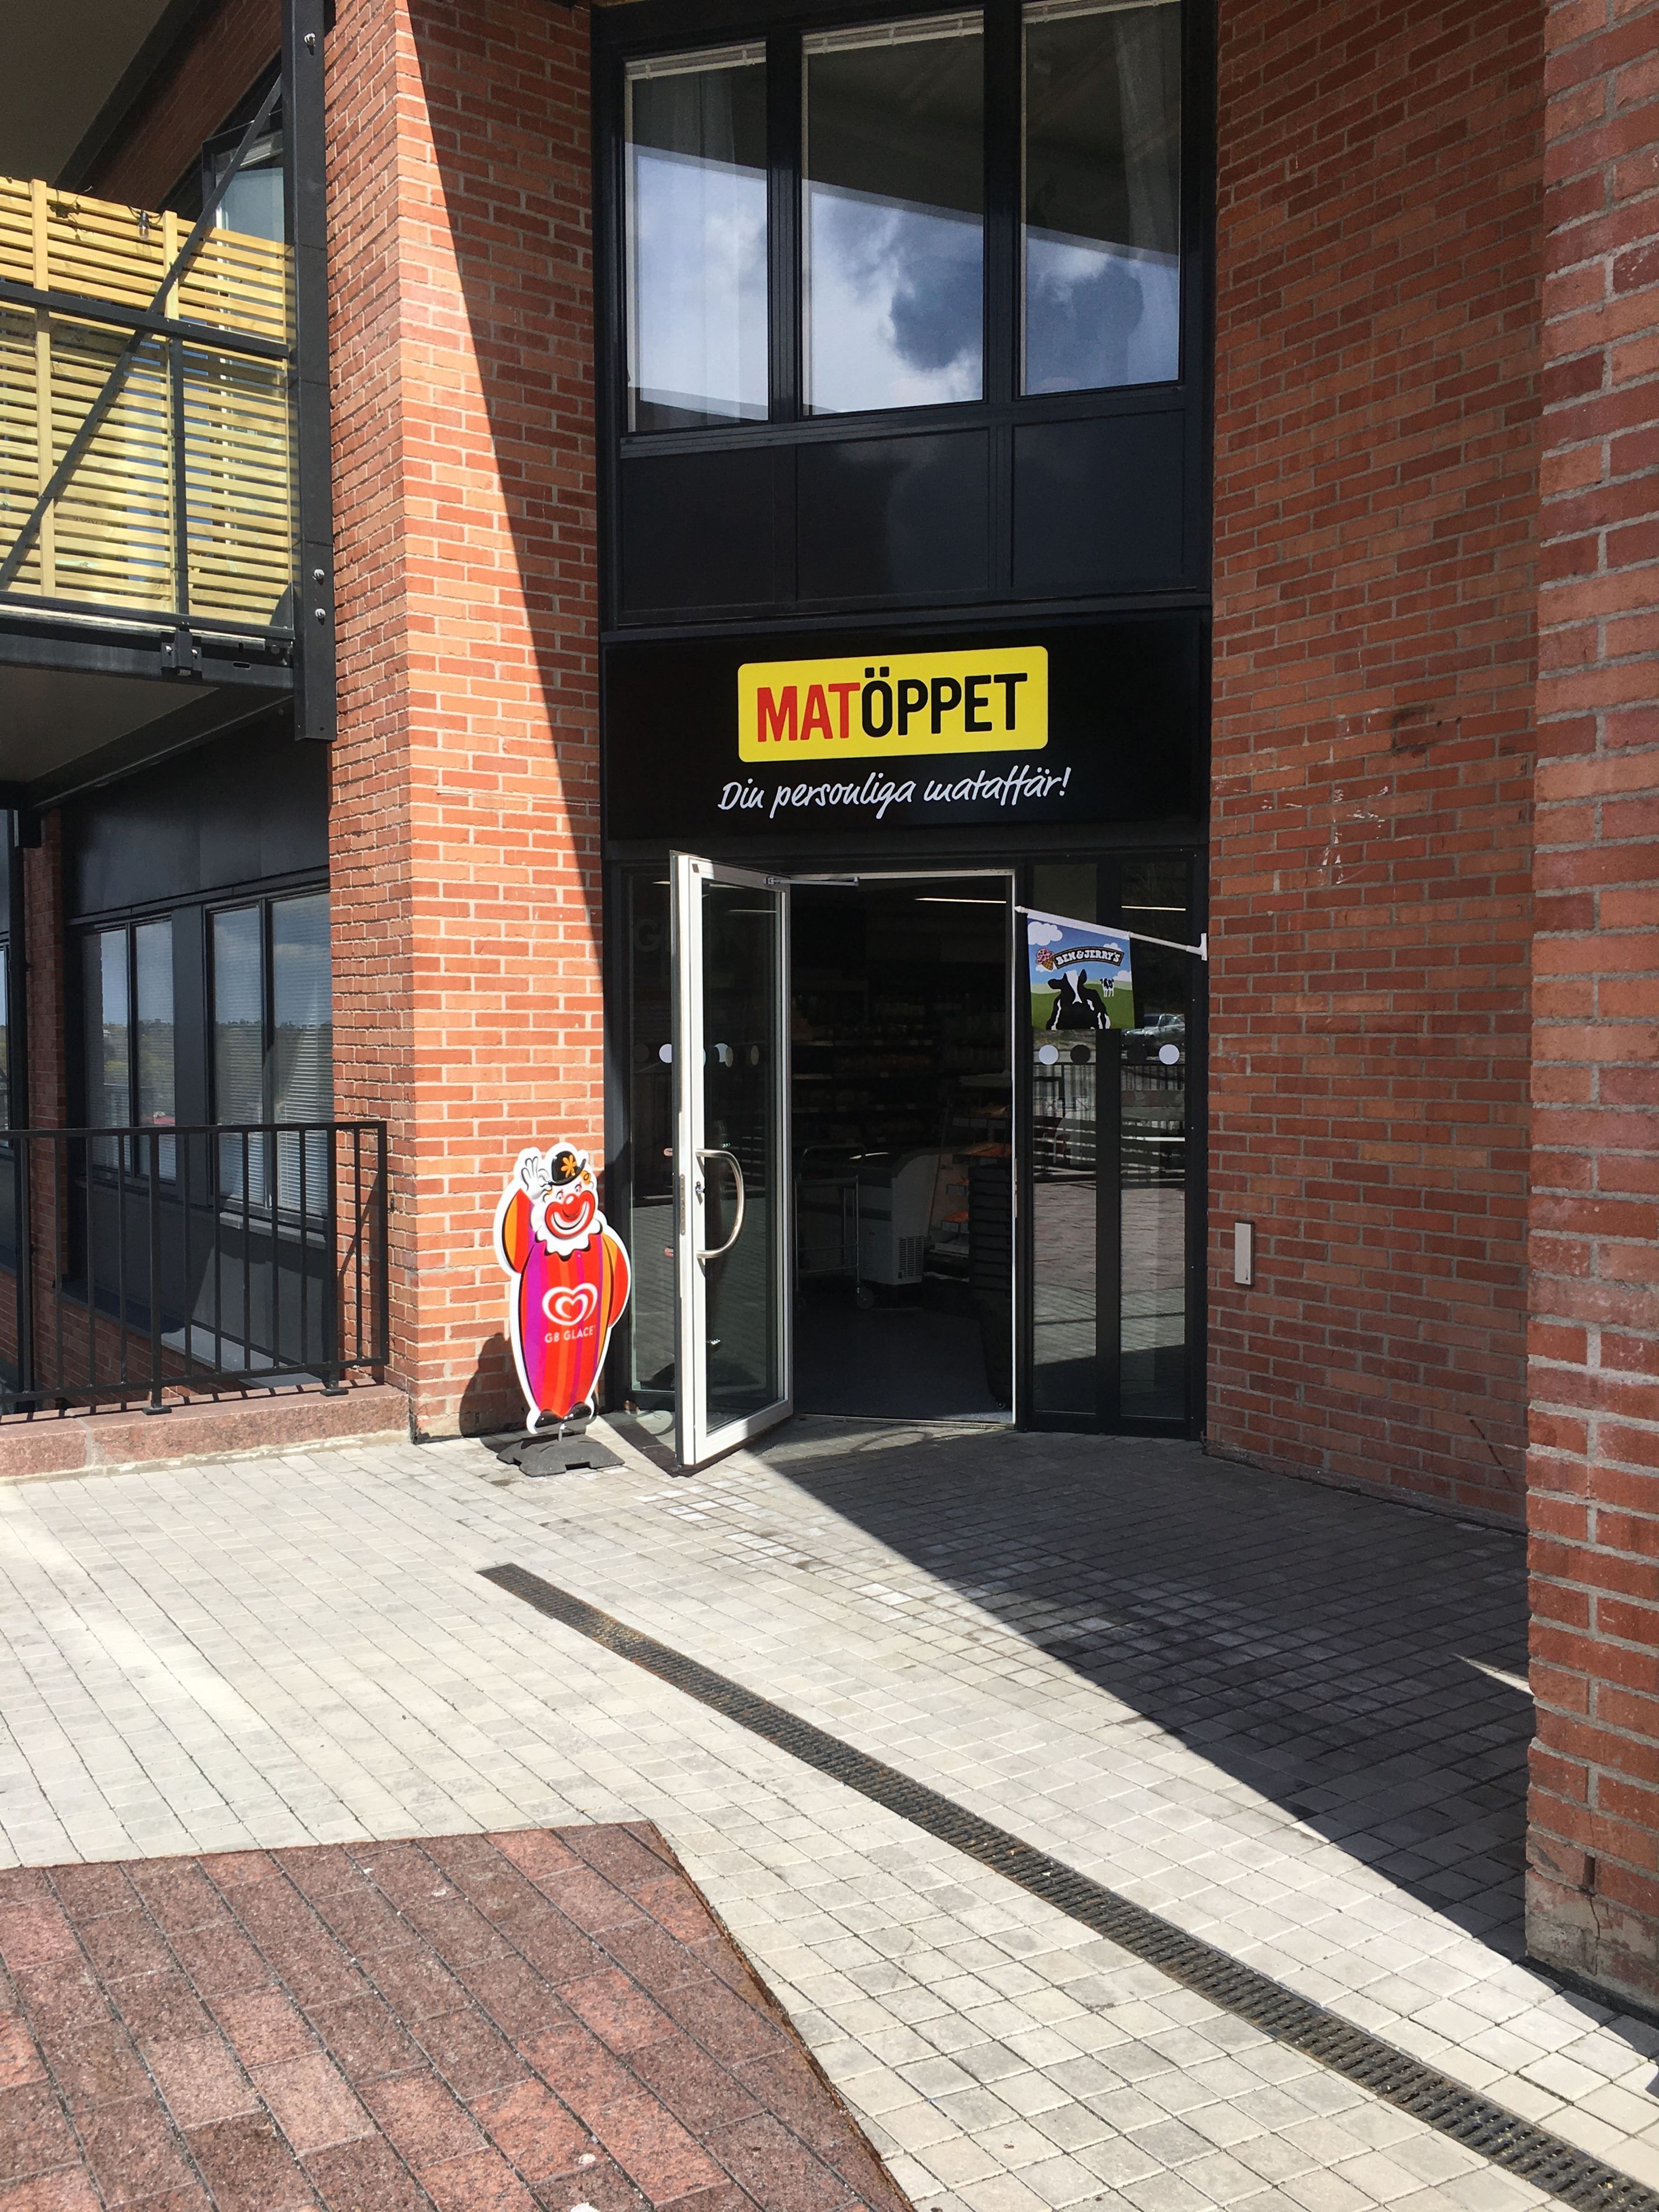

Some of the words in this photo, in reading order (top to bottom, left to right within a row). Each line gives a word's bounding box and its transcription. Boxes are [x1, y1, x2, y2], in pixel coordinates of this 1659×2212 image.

[757, 666, 1028, 742] MATÖPPET
[717, 777, 764, 810] Din
[769, 772, 917, 819] personliga
[924, 764, 1071, 807] mataffär!
[545, 1332, 560, 1343] GB
